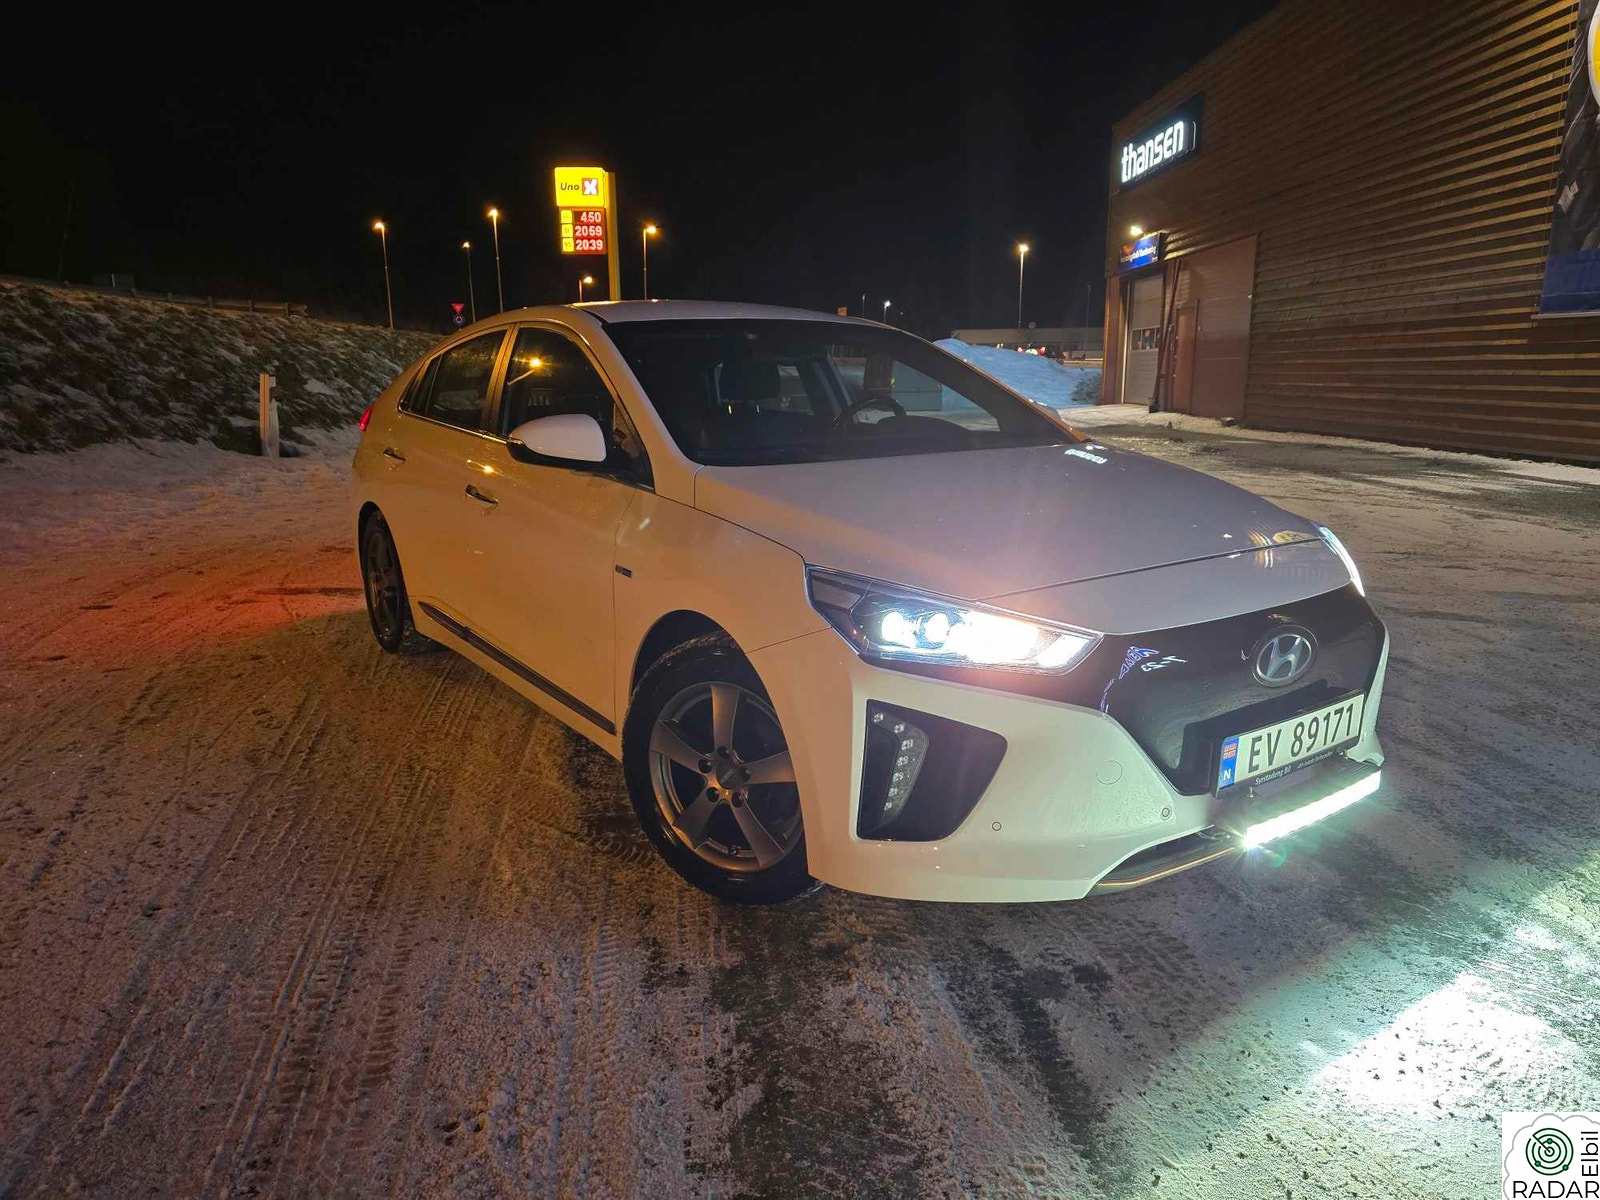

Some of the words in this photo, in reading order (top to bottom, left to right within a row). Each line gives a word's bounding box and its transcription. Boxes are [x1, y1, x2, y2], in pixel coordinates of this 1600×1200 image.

[1121, 121, 1184, 183] thansen
[560, 182, 580, 191] Uno
[583, 178, 598, 195] X
[1248, 729, 1282, 774] EV
[1290, 703, 1354, 758] 89171
[1223, 768, 1232, 781] N
